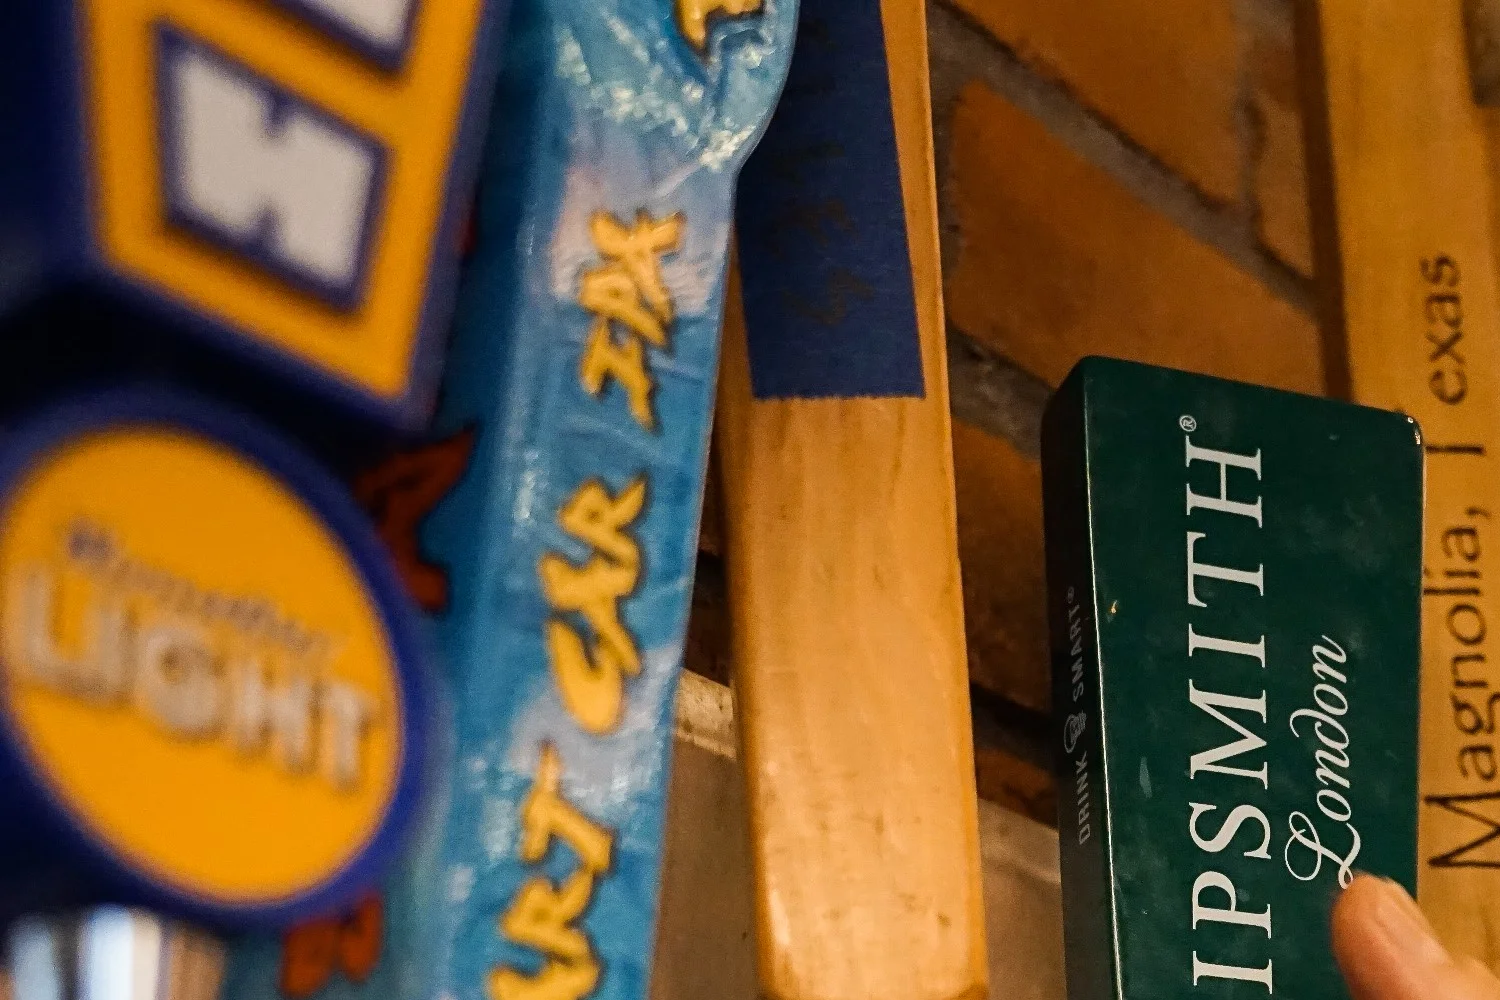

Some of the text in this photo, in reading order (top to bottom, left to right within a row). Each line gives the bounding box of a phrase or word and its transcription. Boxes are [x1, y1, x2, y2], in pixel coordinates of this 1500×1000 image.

[577, 209, 689, 434] IPA
[540, 474, 648, 735] CAR
[1075, 751, 1092, 846] DRINK
[1284, 634, 1362, 890] London
